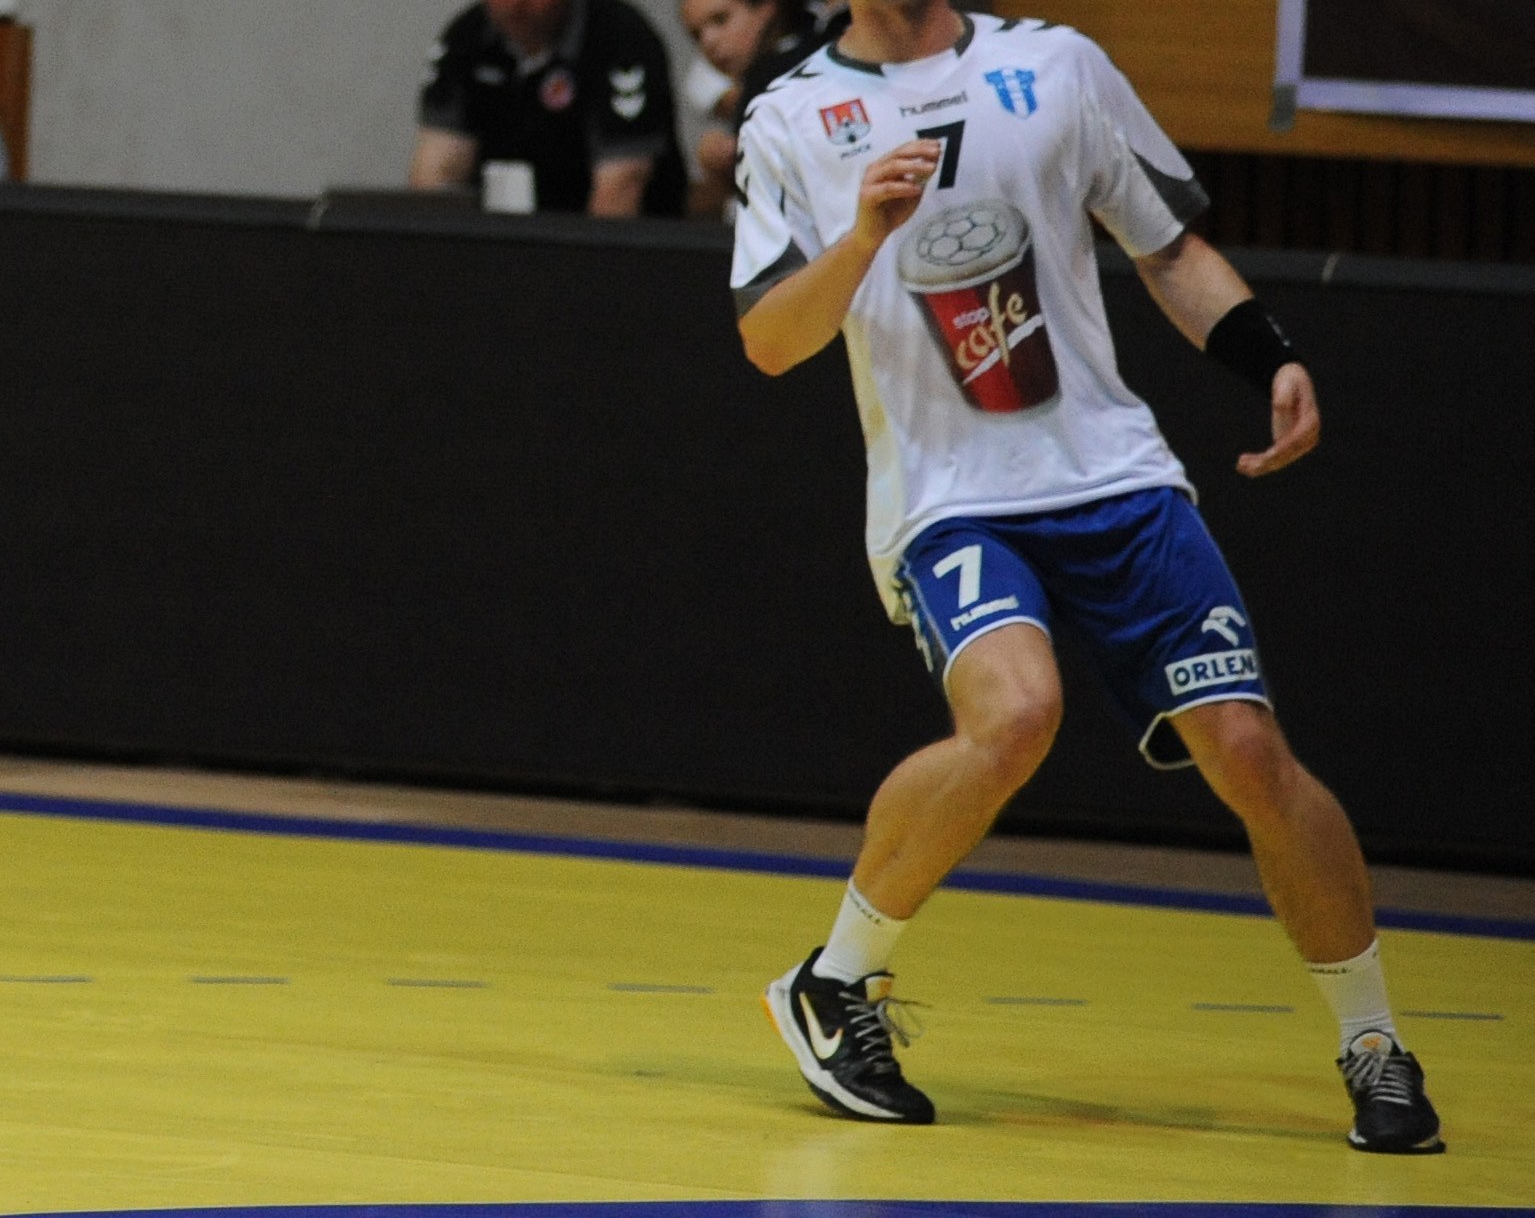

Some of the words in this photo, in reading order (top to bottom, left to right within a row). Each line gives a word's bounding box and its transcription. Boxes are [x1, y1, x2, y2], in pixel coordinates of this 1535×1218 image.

[915, 119, 966, 191] 7
[931, 543, 983, 610] 7
[1172, 654, 1257, 688] ORLEN
